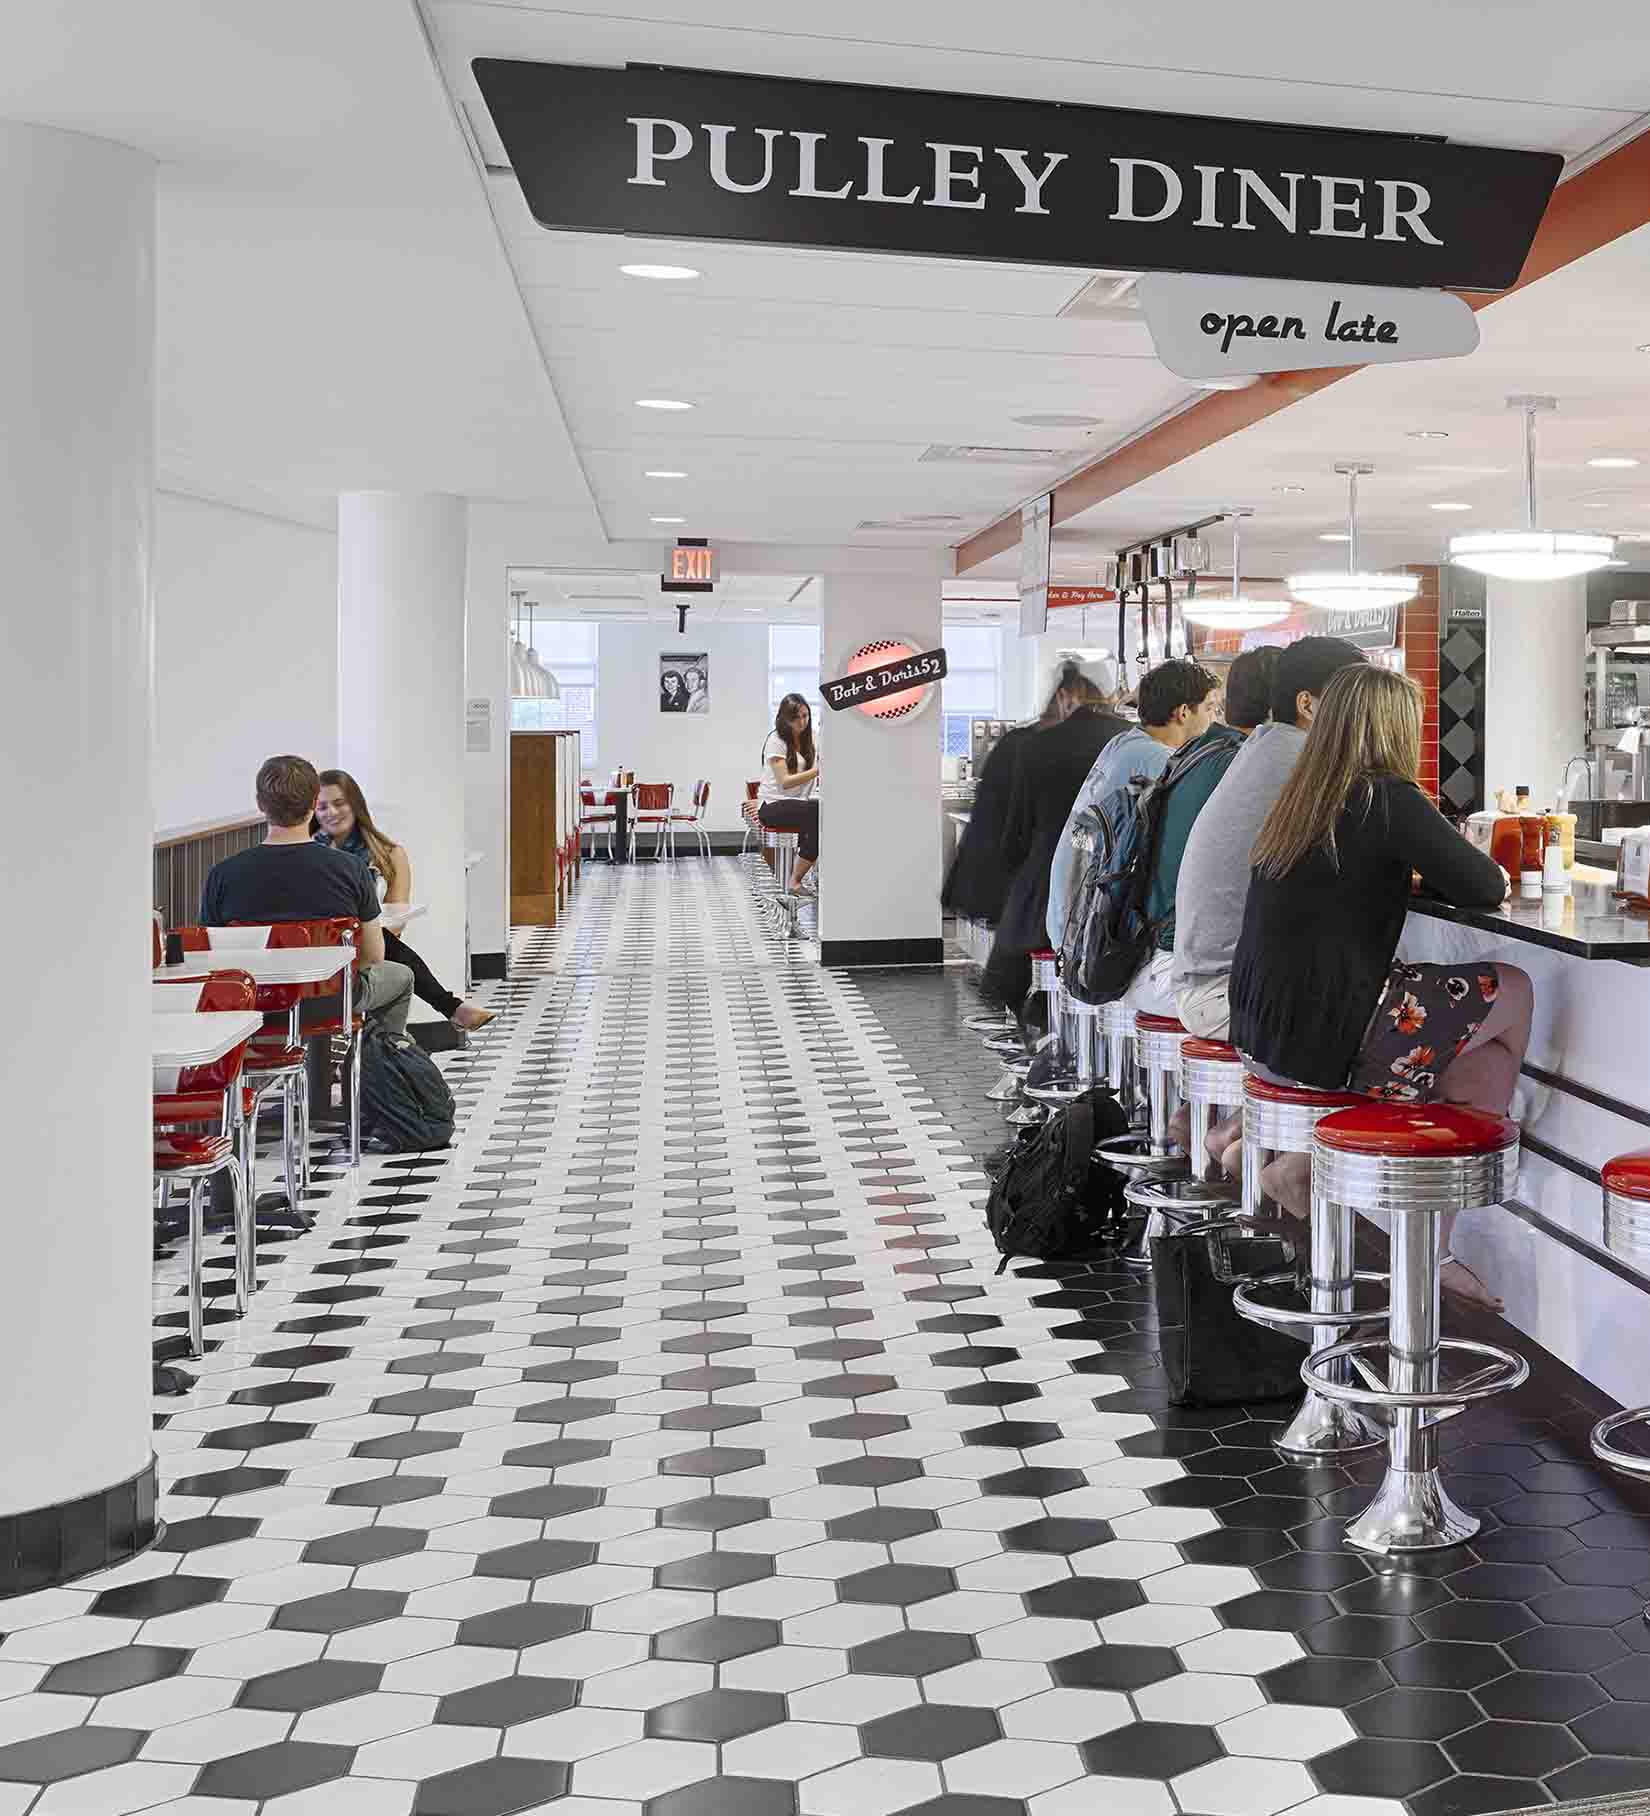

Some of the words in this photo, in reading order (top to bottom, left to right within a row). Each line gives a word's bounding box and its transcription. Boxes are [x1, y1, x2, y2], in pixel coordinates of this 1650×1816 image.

[626, 117, 1069, 214] PULLEY
[1108, 157, 1444, 246] DINER
[1200, 311, 1306, 353] open
[1324, 300, 1399, 343] late
[673, 549, 712, 578] EXIT
[830, 682, 863, 701] Bob
[864, 675, 878, 691] &
